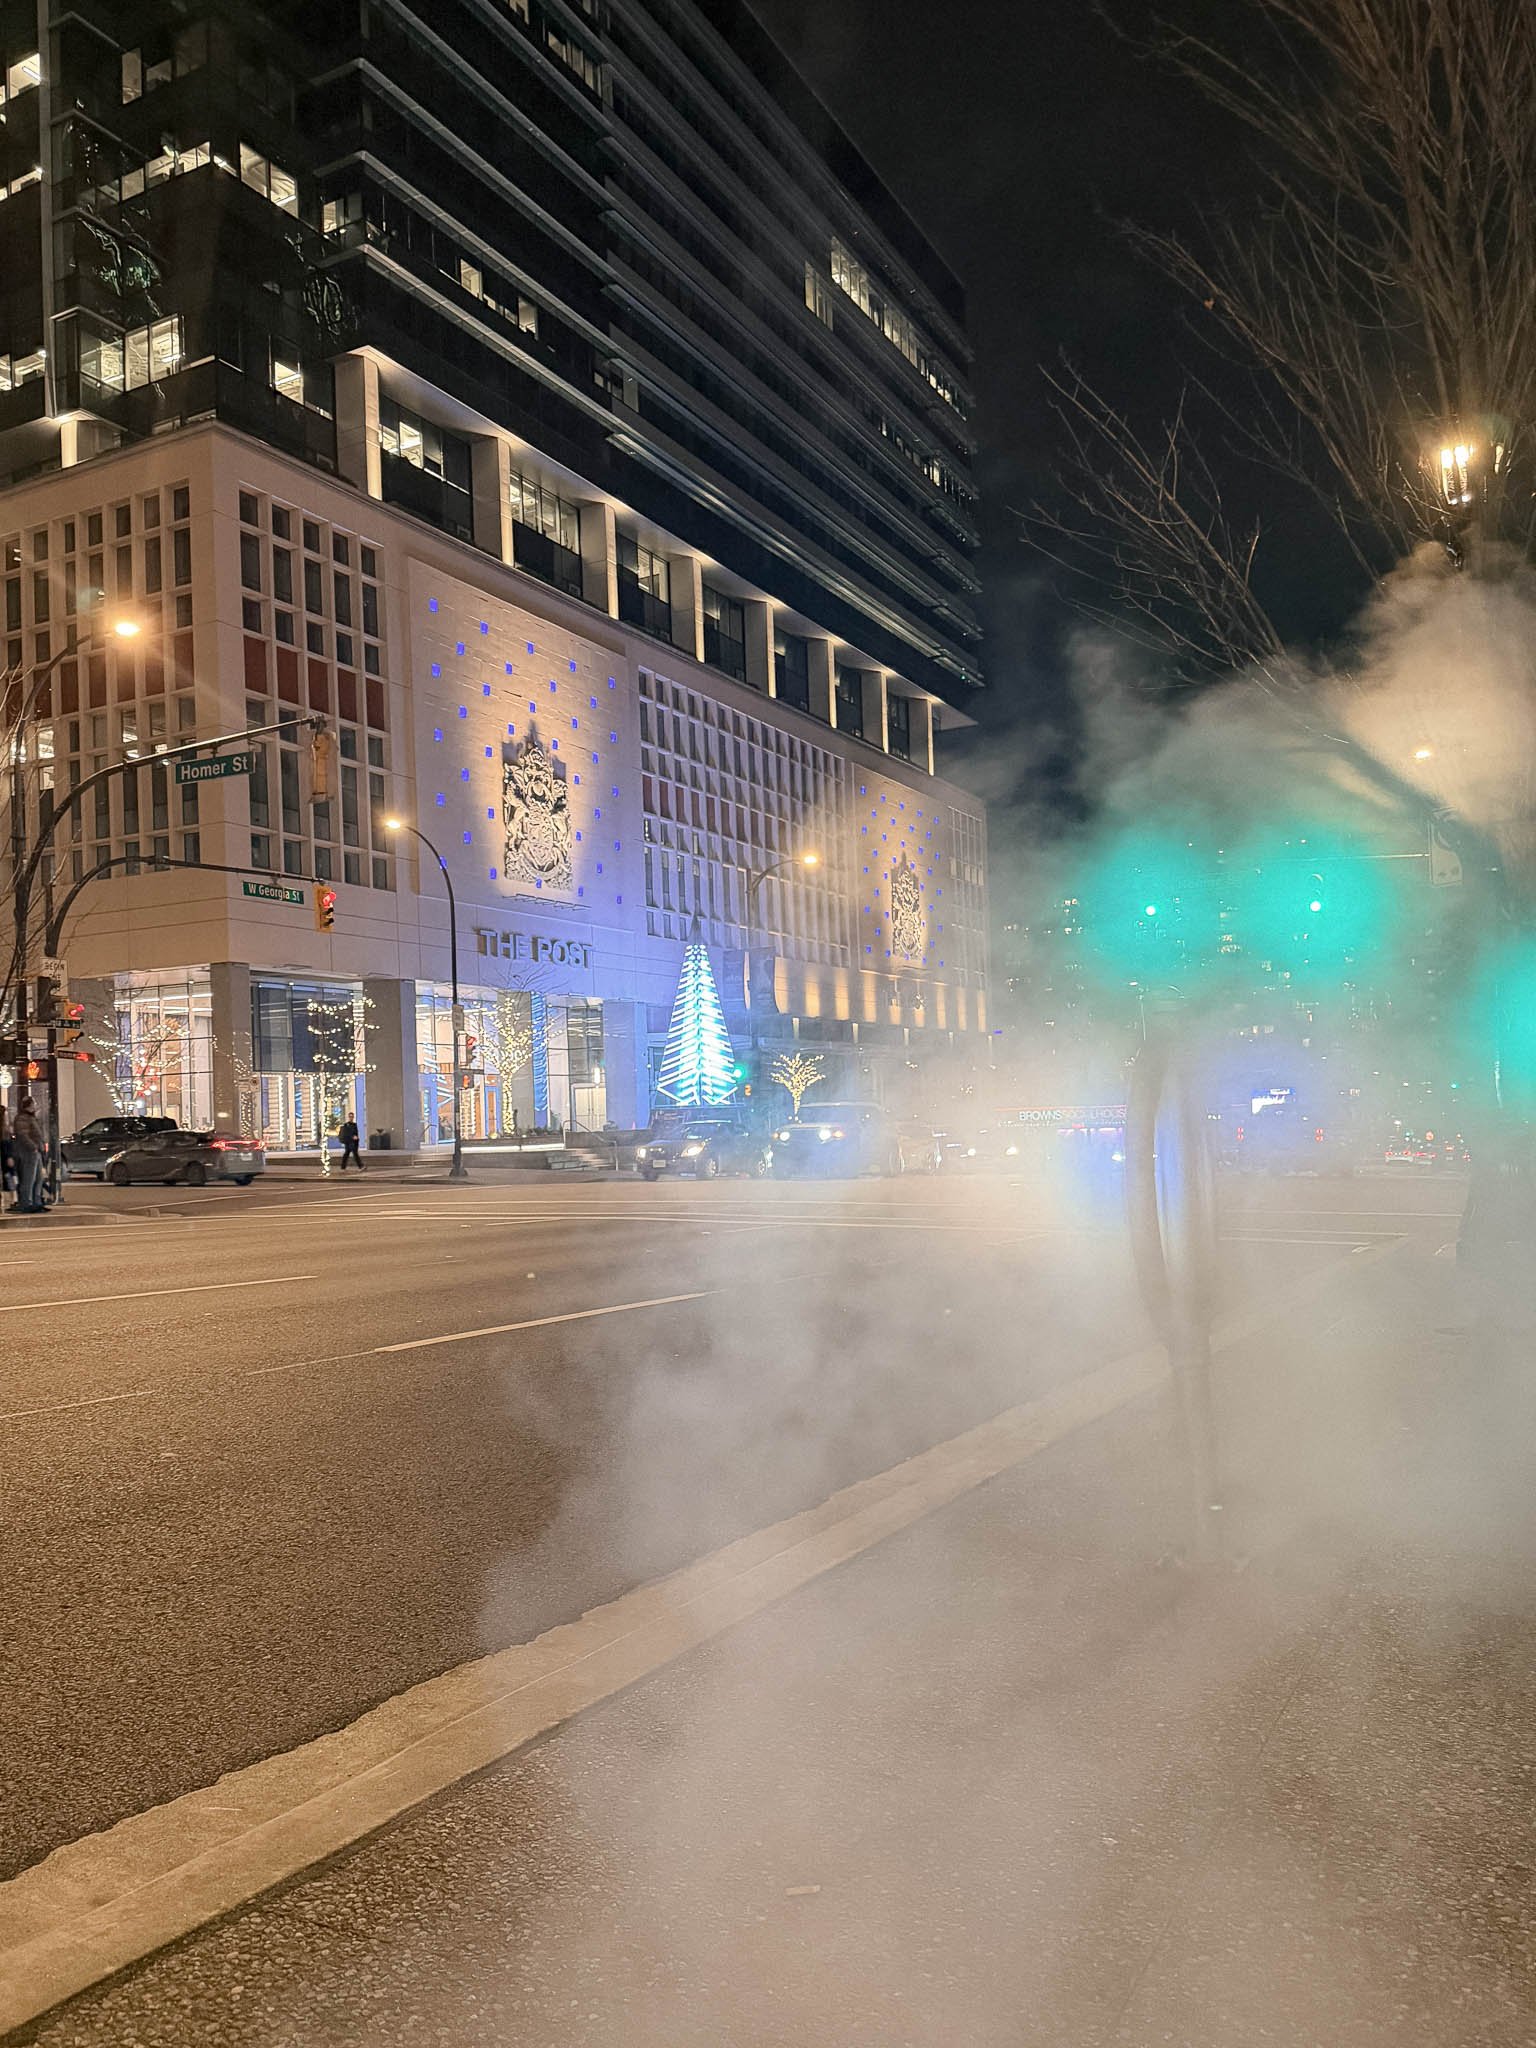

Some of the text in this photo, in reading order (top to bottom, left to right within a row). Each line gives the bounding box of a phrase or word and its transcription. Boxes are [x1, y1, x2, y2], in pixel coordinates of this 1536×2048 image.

[181, 756, 248, 781] Homer St
[248, 883, 300, 902] W Georgia St
[478, 928, 593, 970] THE POST
[1019, 1110, 1062, 1121] BROWNS
